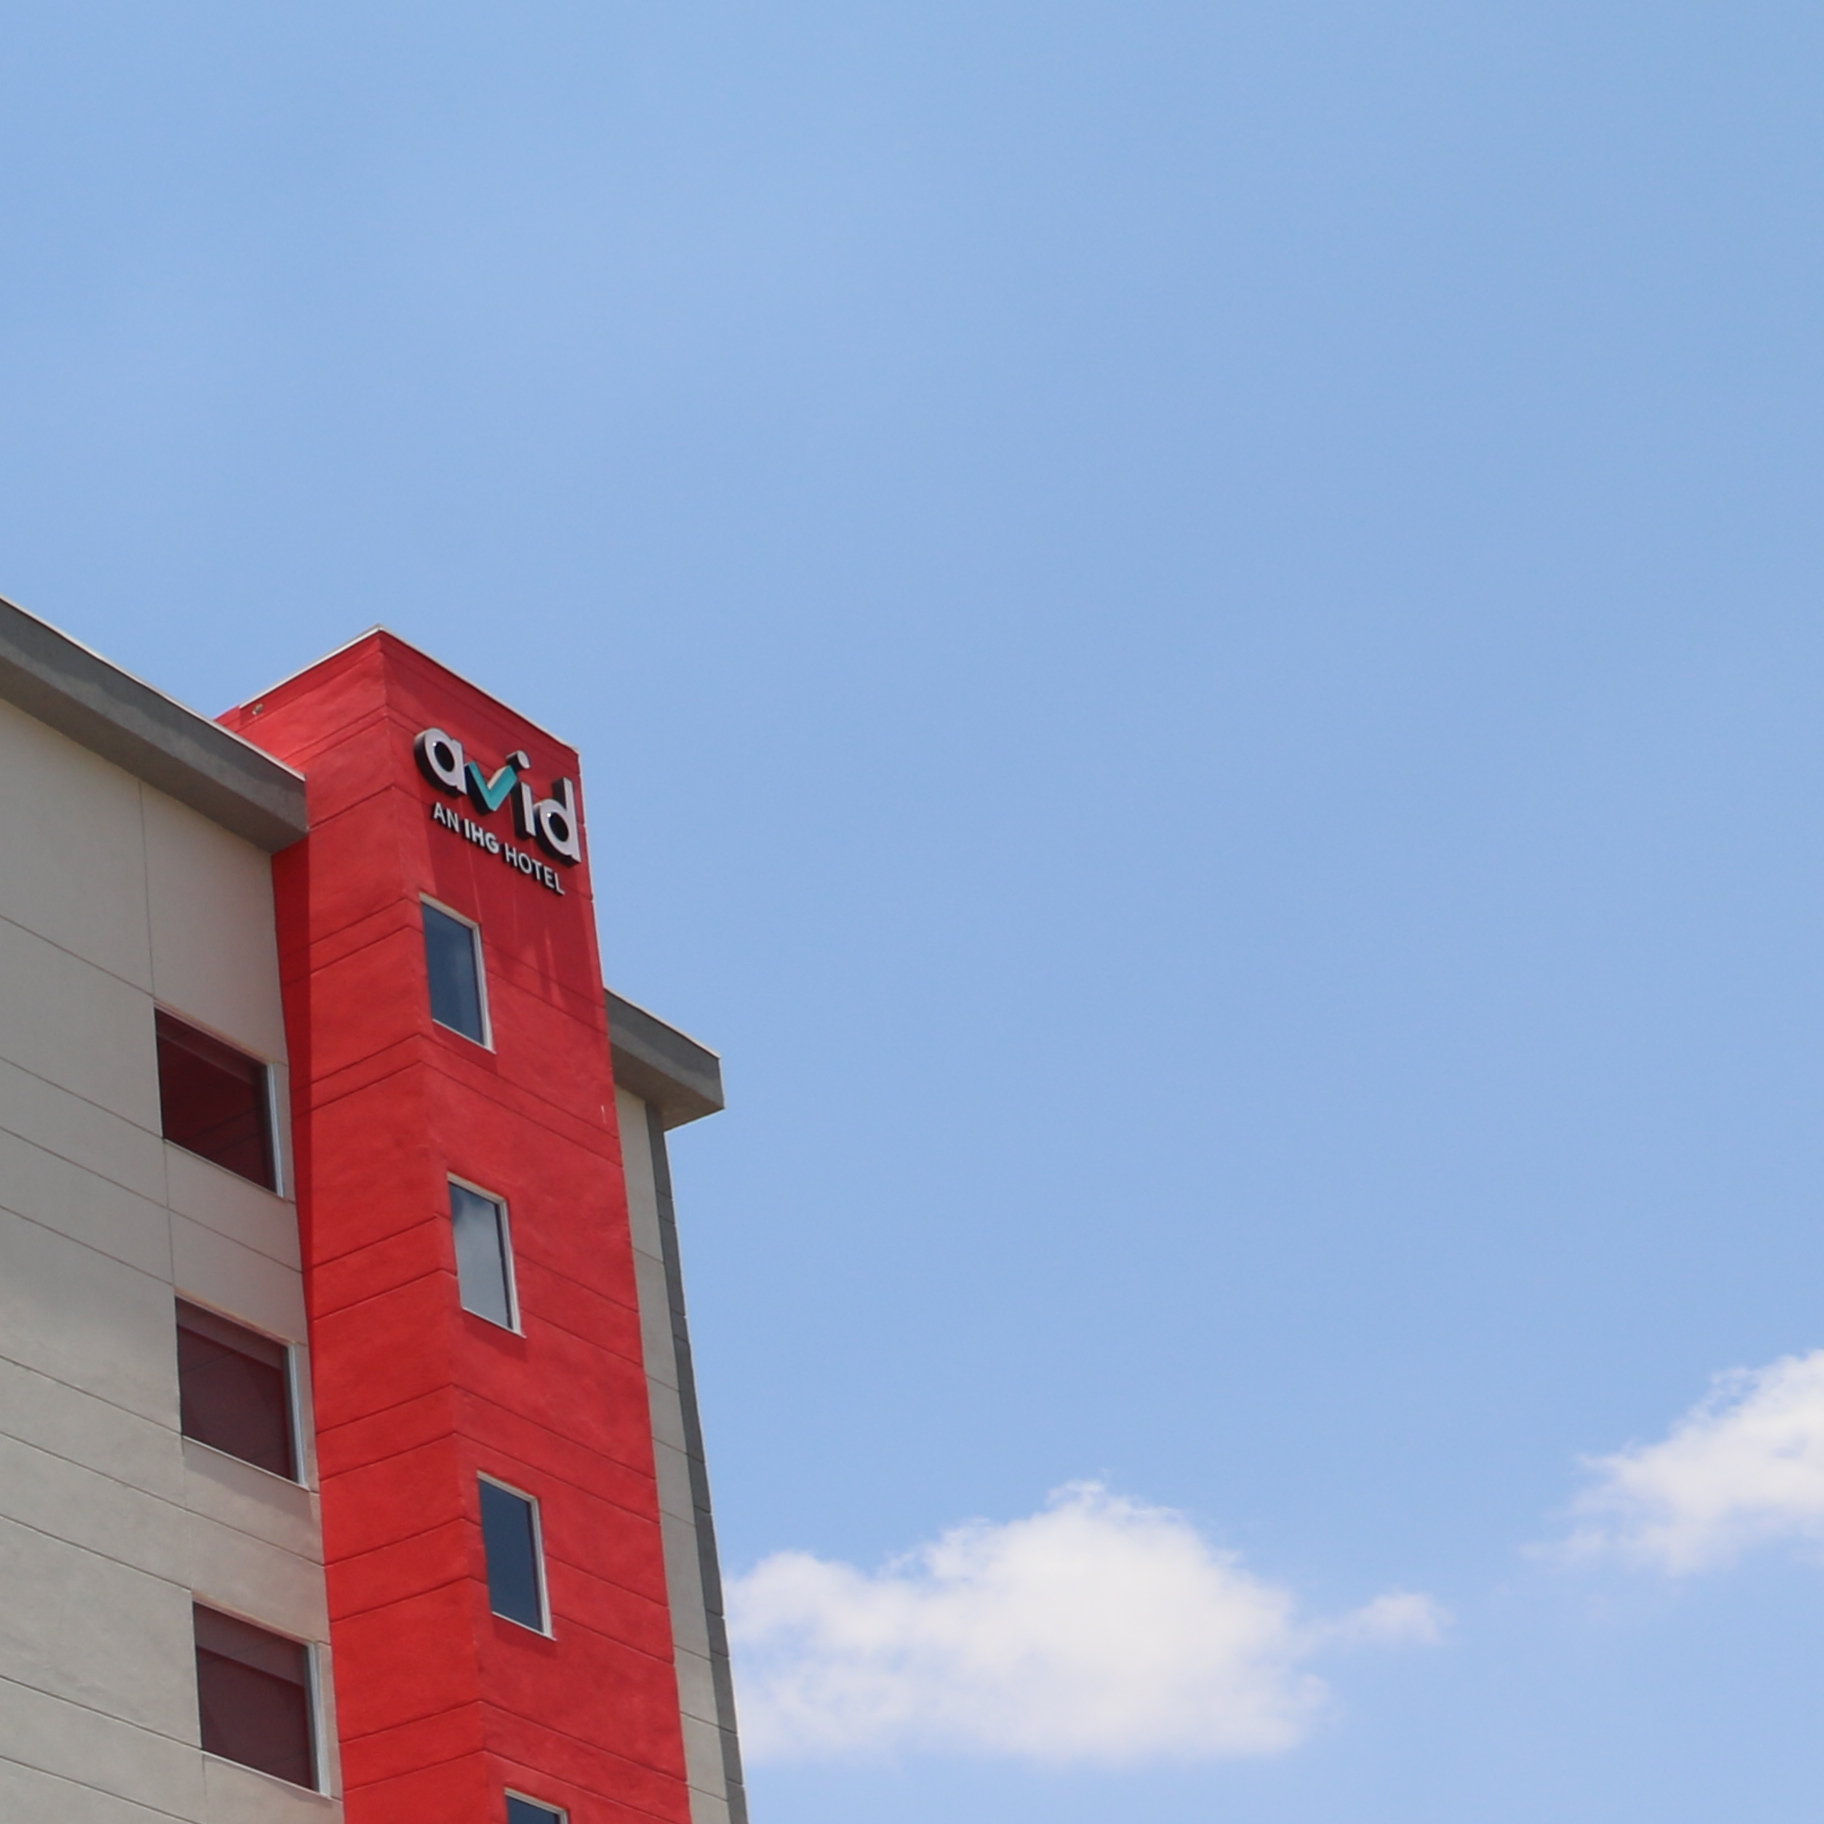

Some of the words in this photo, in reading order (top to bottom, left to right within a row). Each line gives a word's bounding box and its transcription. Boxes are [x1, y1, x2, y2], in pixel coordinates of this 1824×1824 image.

[415, 727, 581, 866] avid
[433, 802, 460, 833] AN
[464, 818, 500, 854] IHG
[504, 843, 566, 896] HOTEL
